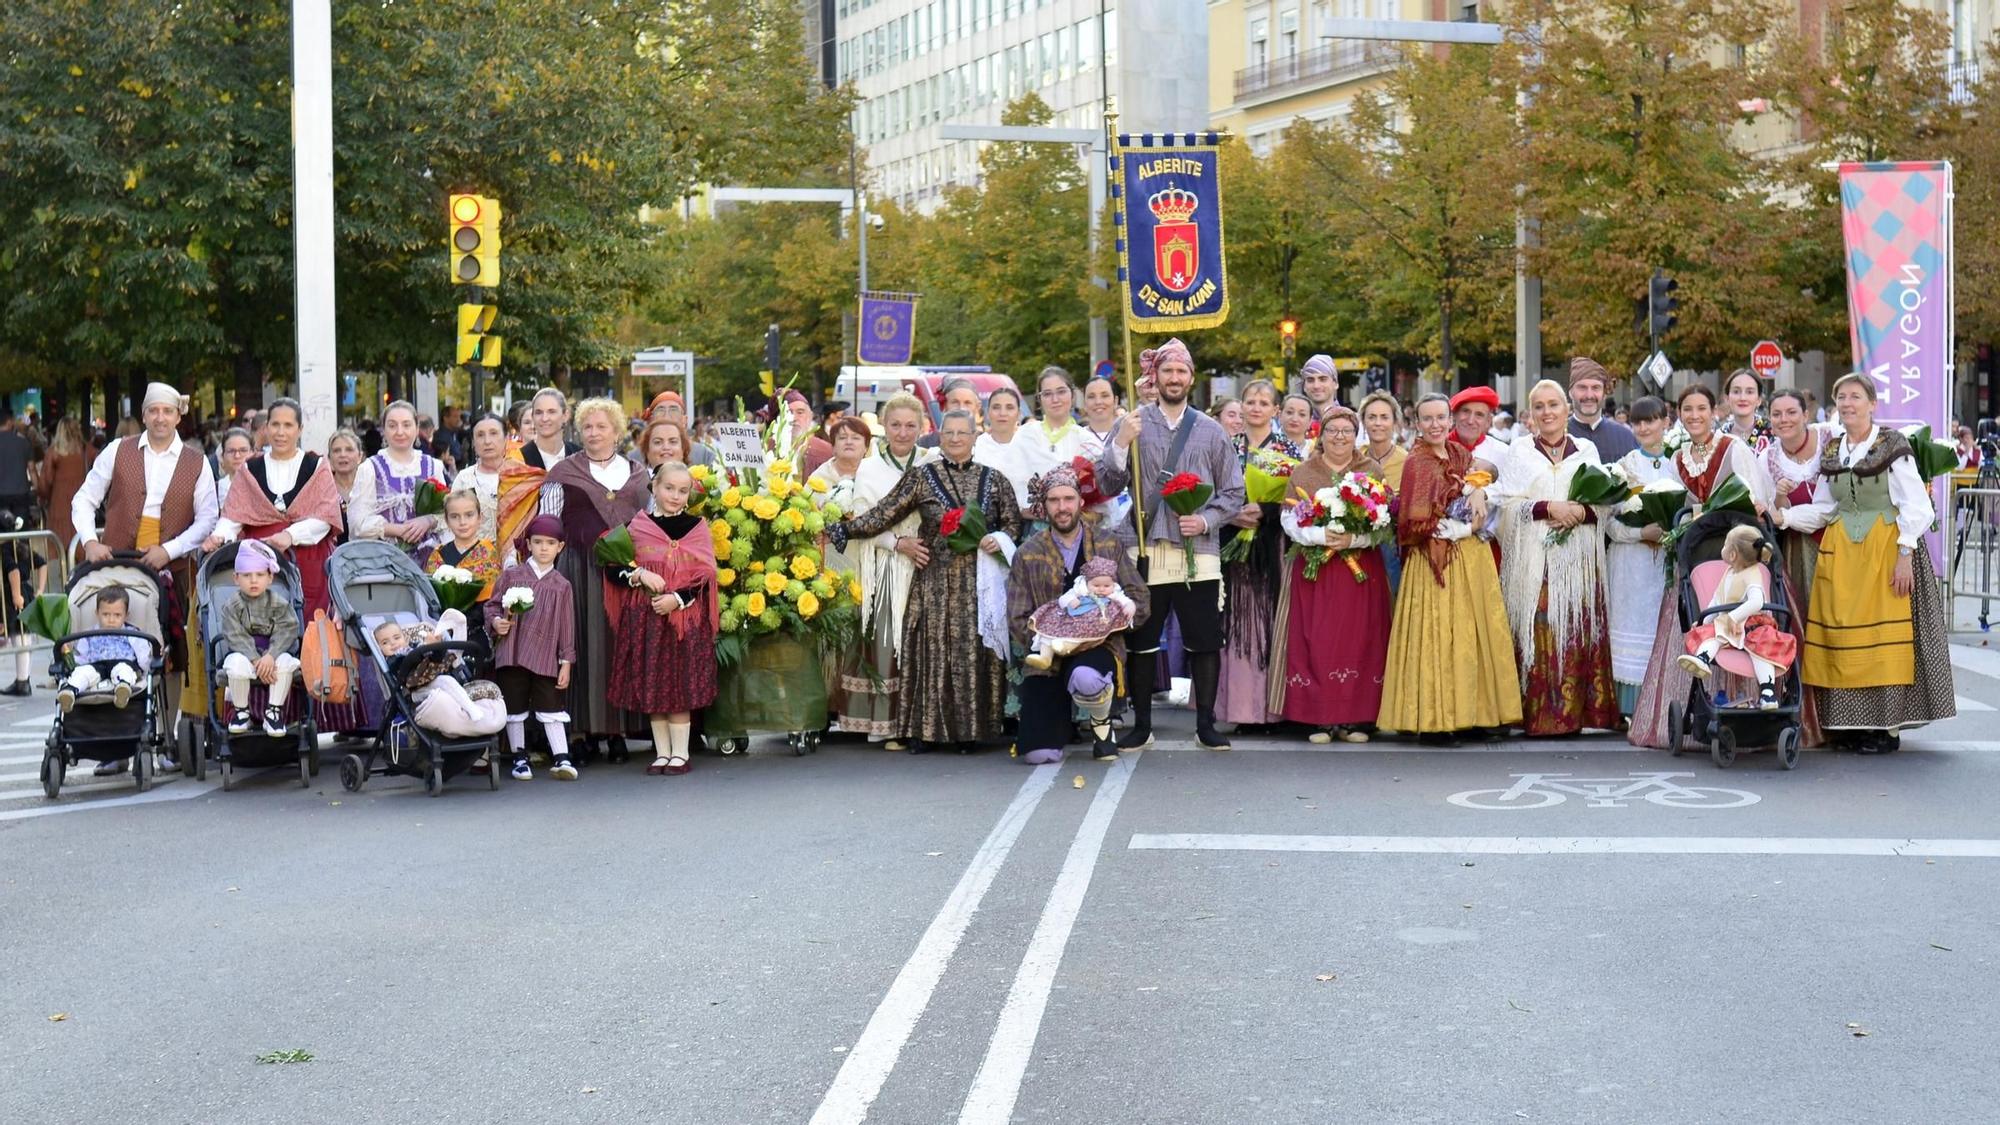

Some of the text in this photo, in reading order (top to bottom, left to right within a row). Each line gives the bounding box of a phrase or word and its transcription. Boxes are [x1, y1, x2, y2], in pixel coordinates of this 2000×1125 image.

[1138, 158, 1203, 181] ALBERITE
[1138, 278, 1217, 316] DE SAN JUAN
[1755, 355, 1779, 365] STOP
[720, 427, 756, 437] ALBERITE
[736, 441, 747, 449] DE
[725, 453, 764, 463] SAN JUAN
